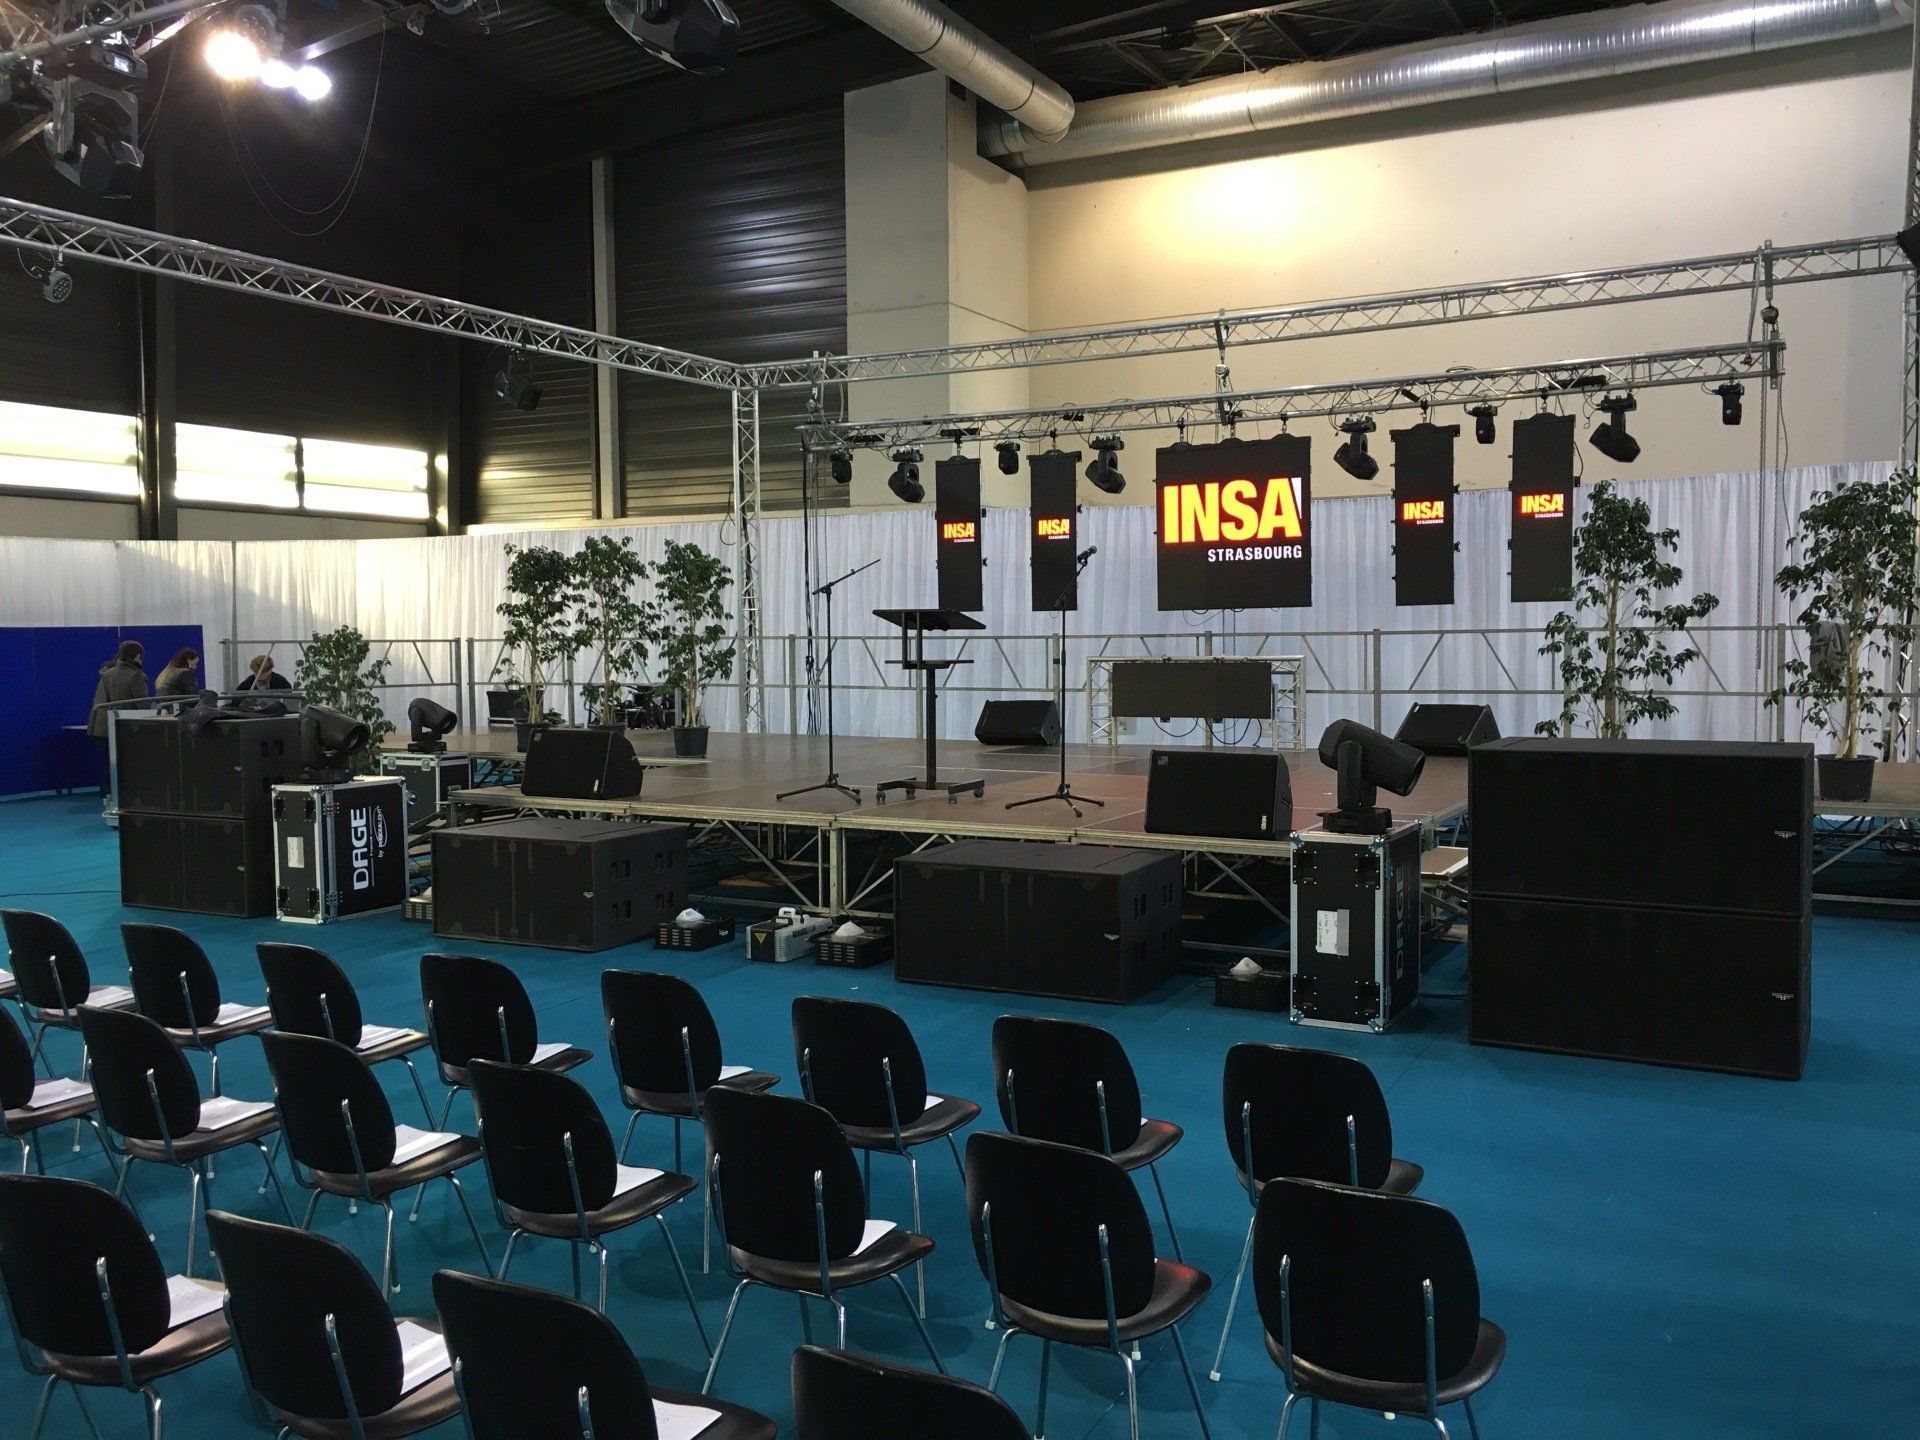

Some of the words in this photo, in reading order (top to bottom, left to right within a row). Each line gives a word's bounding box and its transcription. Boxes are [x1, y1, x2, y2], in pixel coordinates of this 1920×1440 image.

[1164, 477, 1302, 543] INSA
[1403, 501, 1444, 520] INSA
[1521, 494, 1564, 513] INSA
[944, 522, 975, 538] INSA
[1038, 519, 1070, 535] INSA
[1207, 545, 1302, 562] STRASBOURG
[350, 807, 369, 890] DAGE
[377, 849, 385, 858] by
